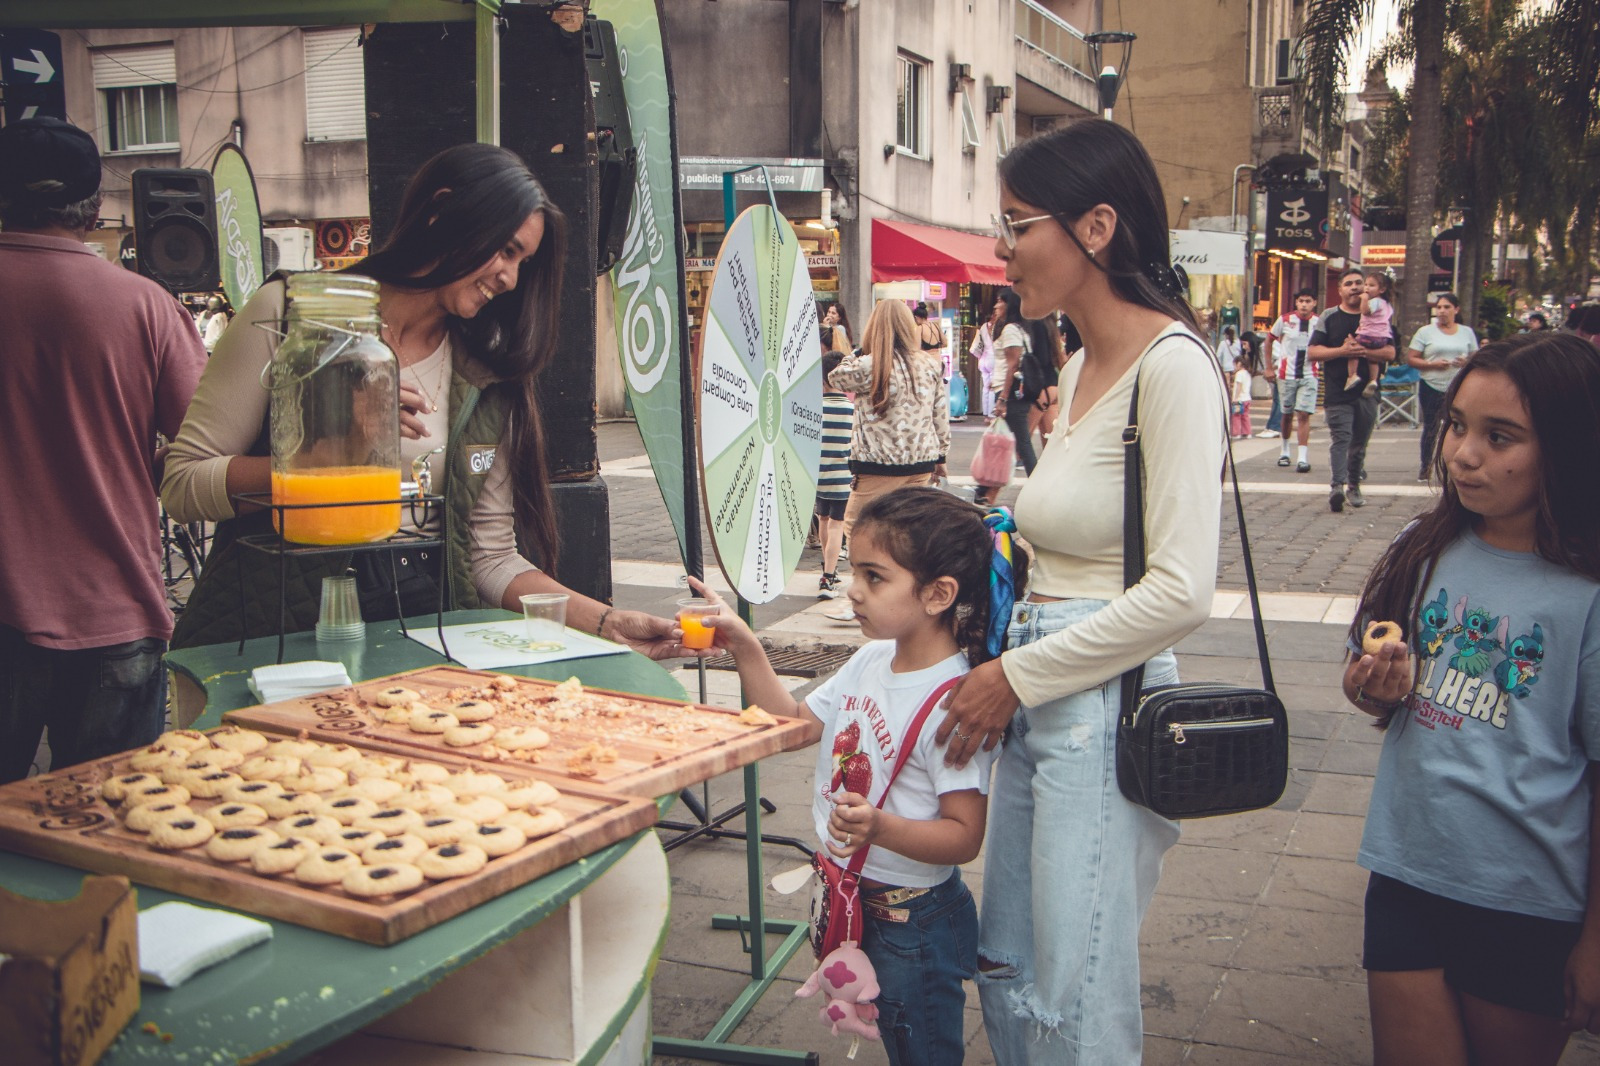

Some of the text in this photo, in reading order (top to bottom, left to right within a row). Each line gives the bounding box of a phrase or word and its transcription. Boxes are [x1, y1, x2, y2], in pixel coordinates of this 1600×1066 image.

[741, 175, 755, 184] Tel:
[758, 174, 795, 184] 42-6974
[1275, 227, 1313, 238] TOSS
[121, 248, 136, 259] AR
[1171, 253, 1208, 264] nus
[727, 260, 739, 290] por
[733, 250, 760, 341] participar!
[782, 335, 794, 362] Bus
[786, 307, 817, 382] p/2 personas
[712, 362, 747, 394] Concordia
[737, 397, 753, 418] Lona
[791, 401, 822, 426] ¡Gracias por
[793, 422, 820, 442] participar!
[715, 436, 755, 534] Nuevamente!
[756, 483, 766, 583] Concordia
[1435, 667, 1510, 730] HERE
